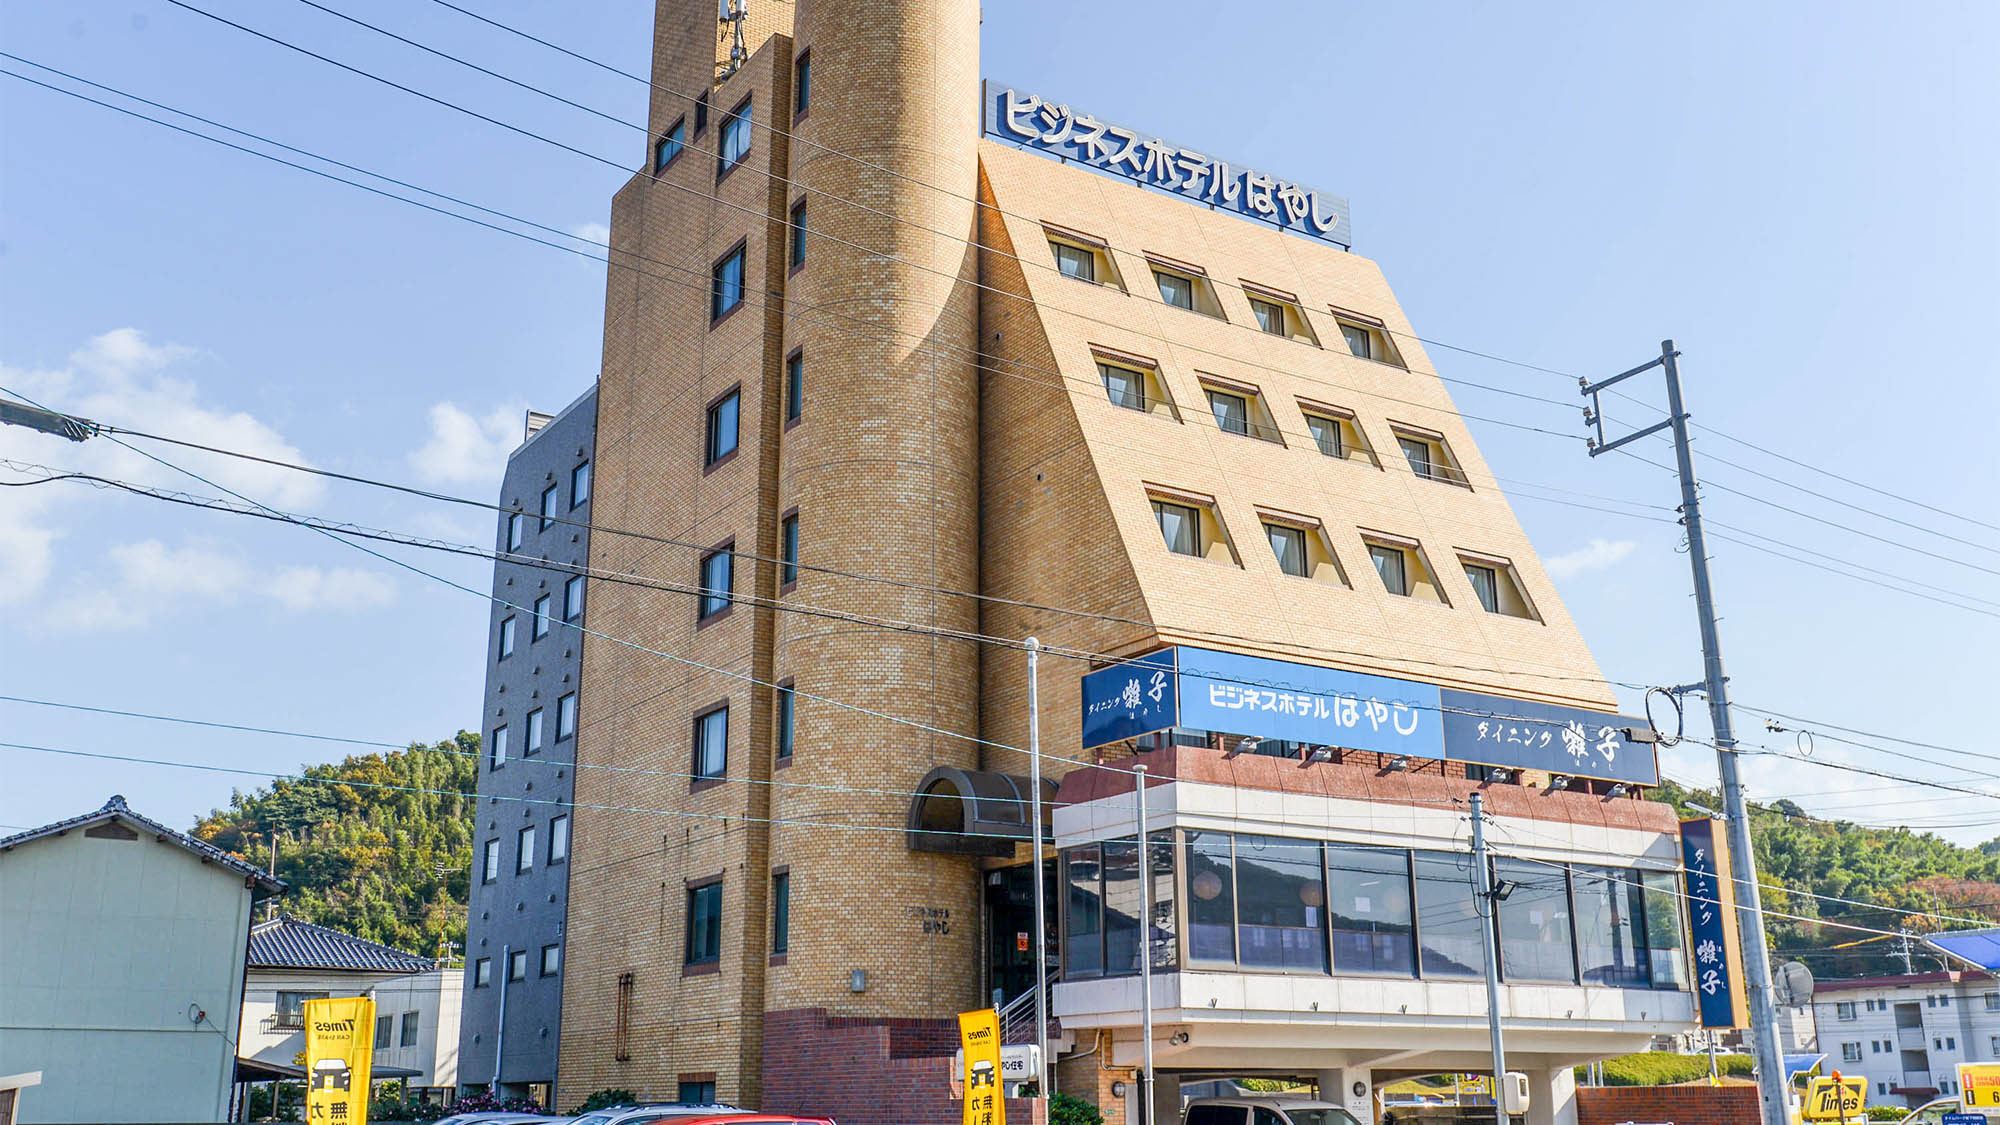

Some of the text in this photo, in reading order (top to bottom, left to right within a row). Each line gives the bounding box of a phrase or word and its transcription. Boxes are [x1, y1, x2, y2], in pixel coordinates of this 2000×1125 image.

[1694, 848, 1712, 926] ダイニング
